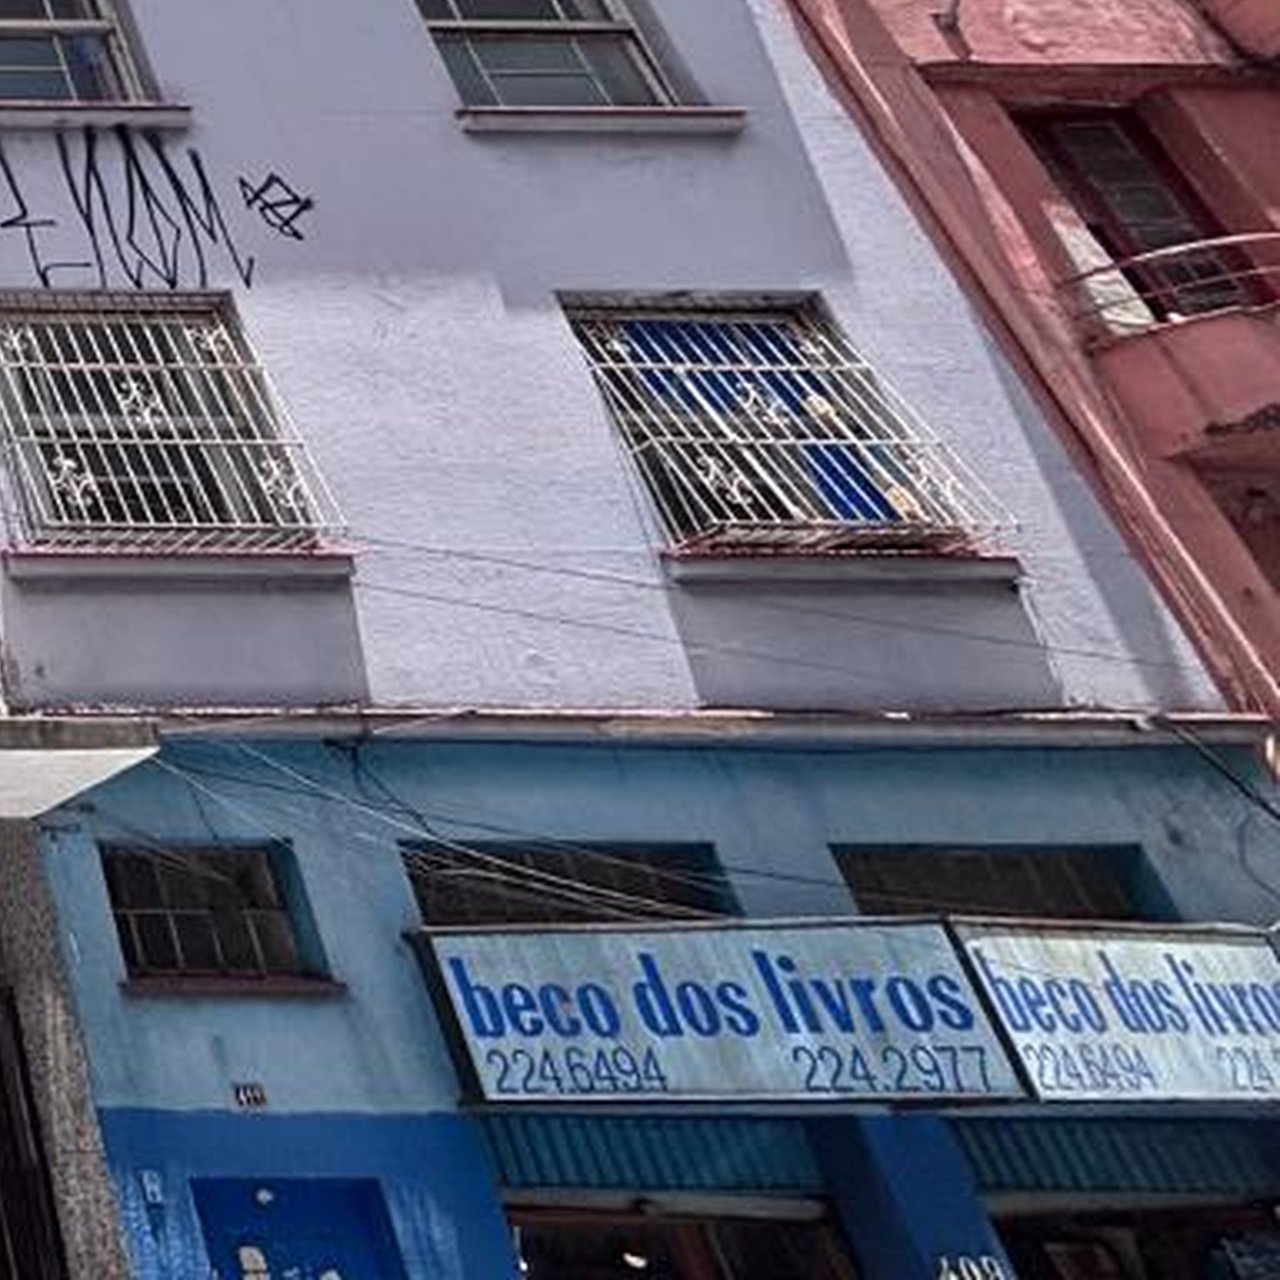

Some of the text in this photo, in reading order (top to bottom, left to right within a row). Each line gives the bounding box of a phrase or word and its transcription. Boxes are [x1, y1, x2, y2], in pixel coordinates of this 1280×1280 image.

[448, 949, 975, 1039] beco dos livros
[971, 947, 1280, 1036] beco dos livro
[792, 1045, 991, 1093] 224.2977
